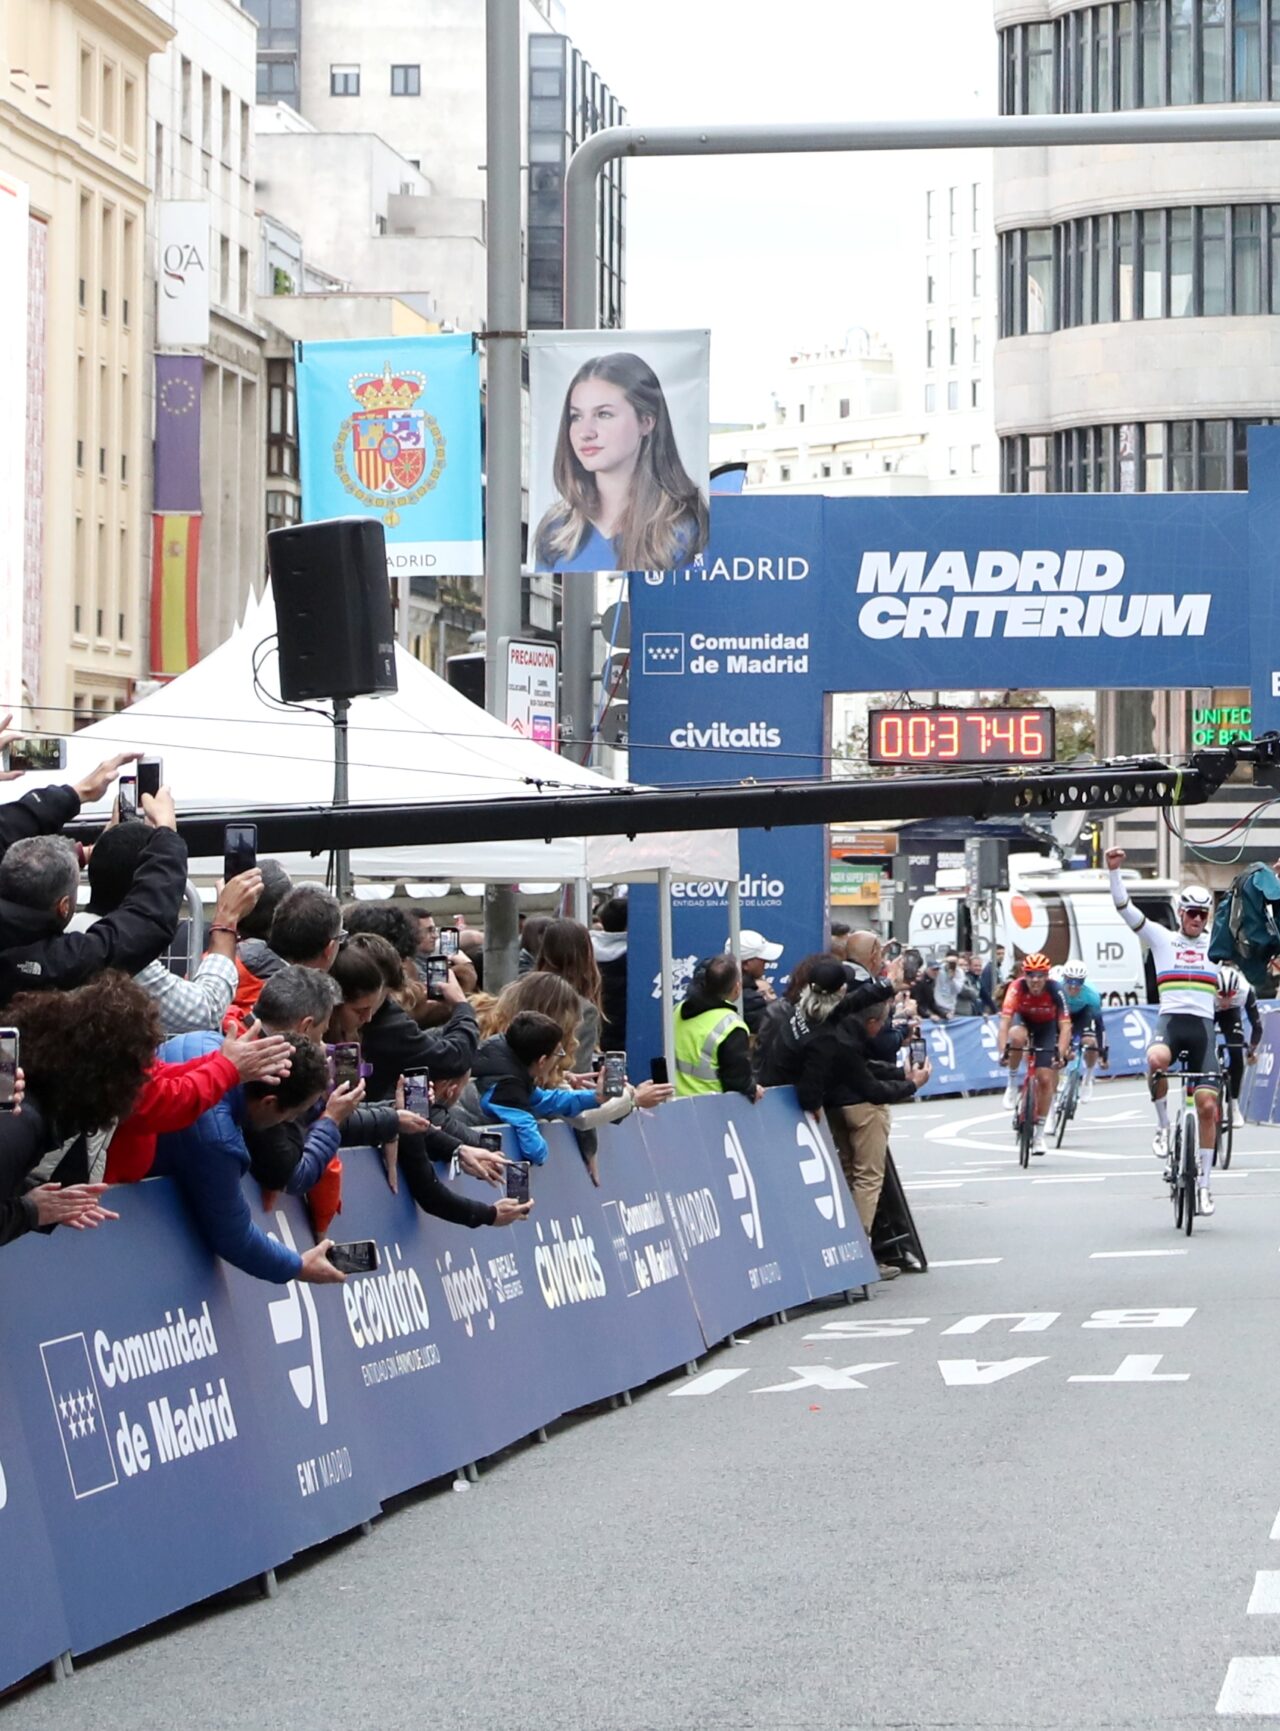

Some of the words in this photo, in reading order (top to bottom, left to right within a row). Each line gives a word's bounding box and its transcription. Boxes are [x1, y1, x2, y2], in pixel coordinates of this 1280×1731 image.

[386, 553, 437, 568] ADRID
[856, 548, 1125, 594] MADRID
[857, 592, 1212, 640] CRITERIUM
[690, 633, 809, 650] Comunidad
[511, 648, 554, 669] PRECAUCIÓN
[690, 655, 719, 674] de
[726, 655, 809, 674] Madrid
[1192, 707, 1252, 725] UNITED
[670, 722, 782, 748] civitatis
[880, 715, 1043, 757] 00:37:46
[1192, 728, 1215, 746] OF
[671, 873, 785, 898] ecovdrio
[1096, 942, 1125, 961] HD
[675, 1187, 721, 1249] MADRID
[534, 1214, 607, 1310] civitatis
[821, 1246, 840, 1268] EMT
[342, 1242, 430, 1349] ecovidrio
[801, 1307, 1199, 1340] BUS
[93, 1300, 218, 1388] Comunidad
[361, 1359, 389, 1387] ENTIDAD
[667, 1353, 1193, 1397] TAXI
[116, 1410, 151, 1477] de
[147, 1377, 238, 1464] Madrid
[296, 1458, 320, 1497] EMT
[318, 1446, 353, 1489] MADRID
